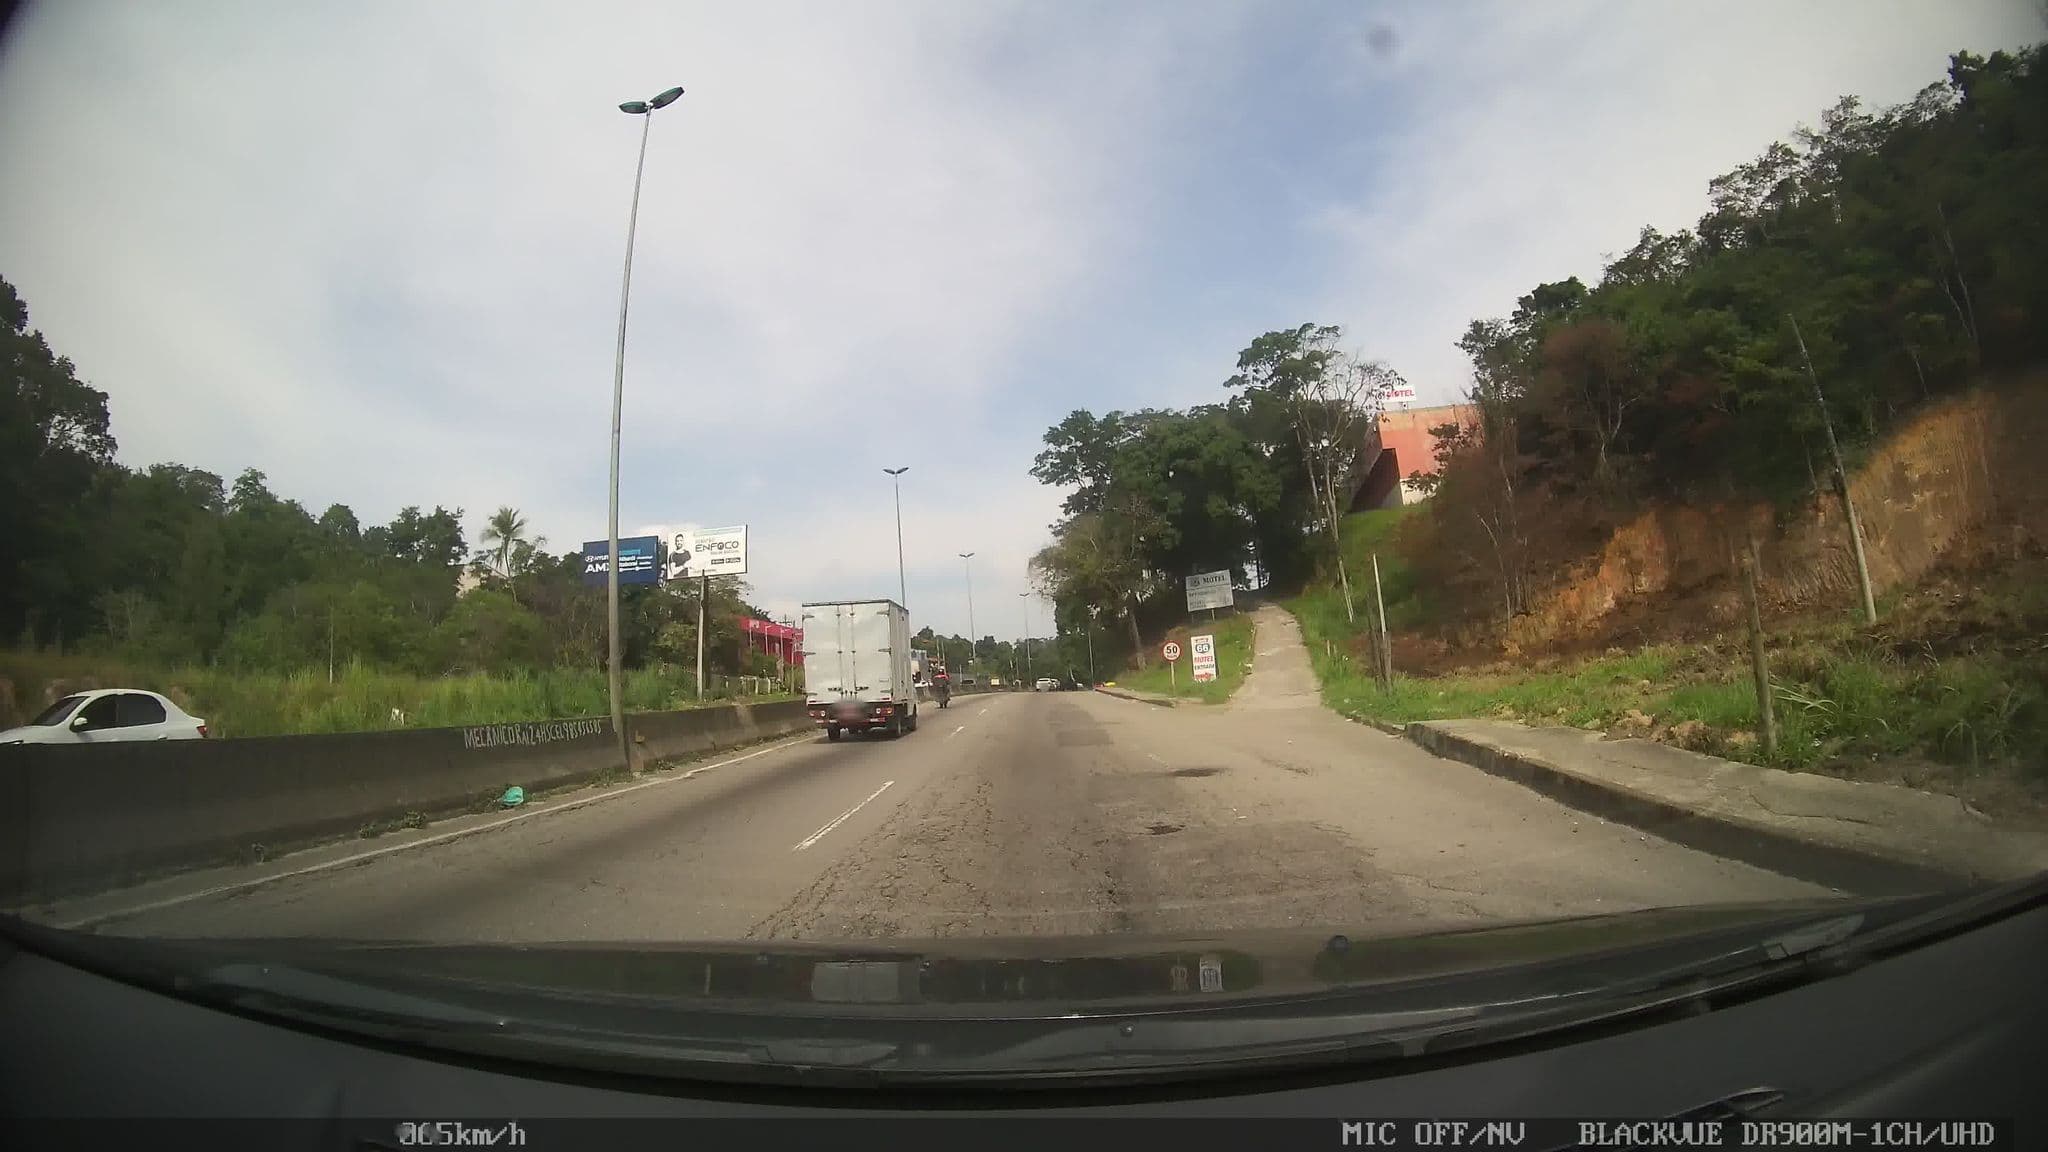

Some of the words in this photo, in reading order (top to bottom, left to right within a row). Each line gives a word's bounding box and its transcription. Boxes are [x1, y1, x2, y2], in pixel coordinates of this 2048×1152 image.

[695, 540, 739, 552] ENFOCO
[1166, 645, 1178, 653] 50
[1196, 644, 1209, 653] 66
